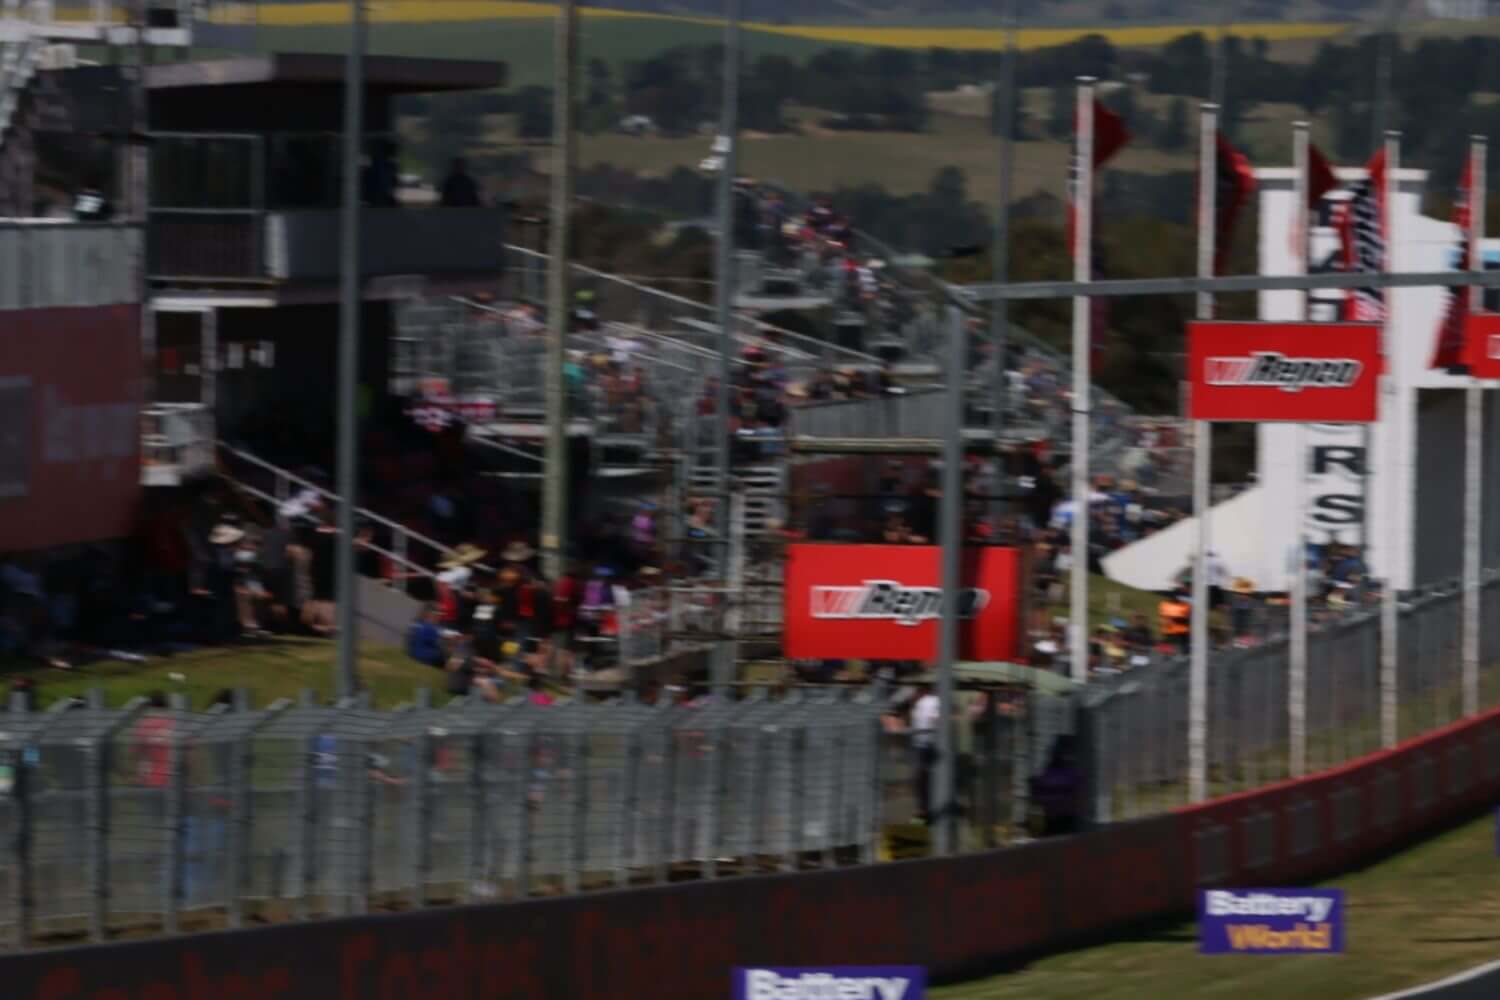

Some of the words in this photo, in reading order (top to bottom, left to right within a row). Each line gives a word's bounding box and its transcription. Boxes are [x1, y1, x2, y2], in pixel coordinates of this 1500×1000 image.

[1248, 351, 1363, 392] Repco
[1205, 889, 1335, 922] Battery
[1225, 922, 1332, 949] World
